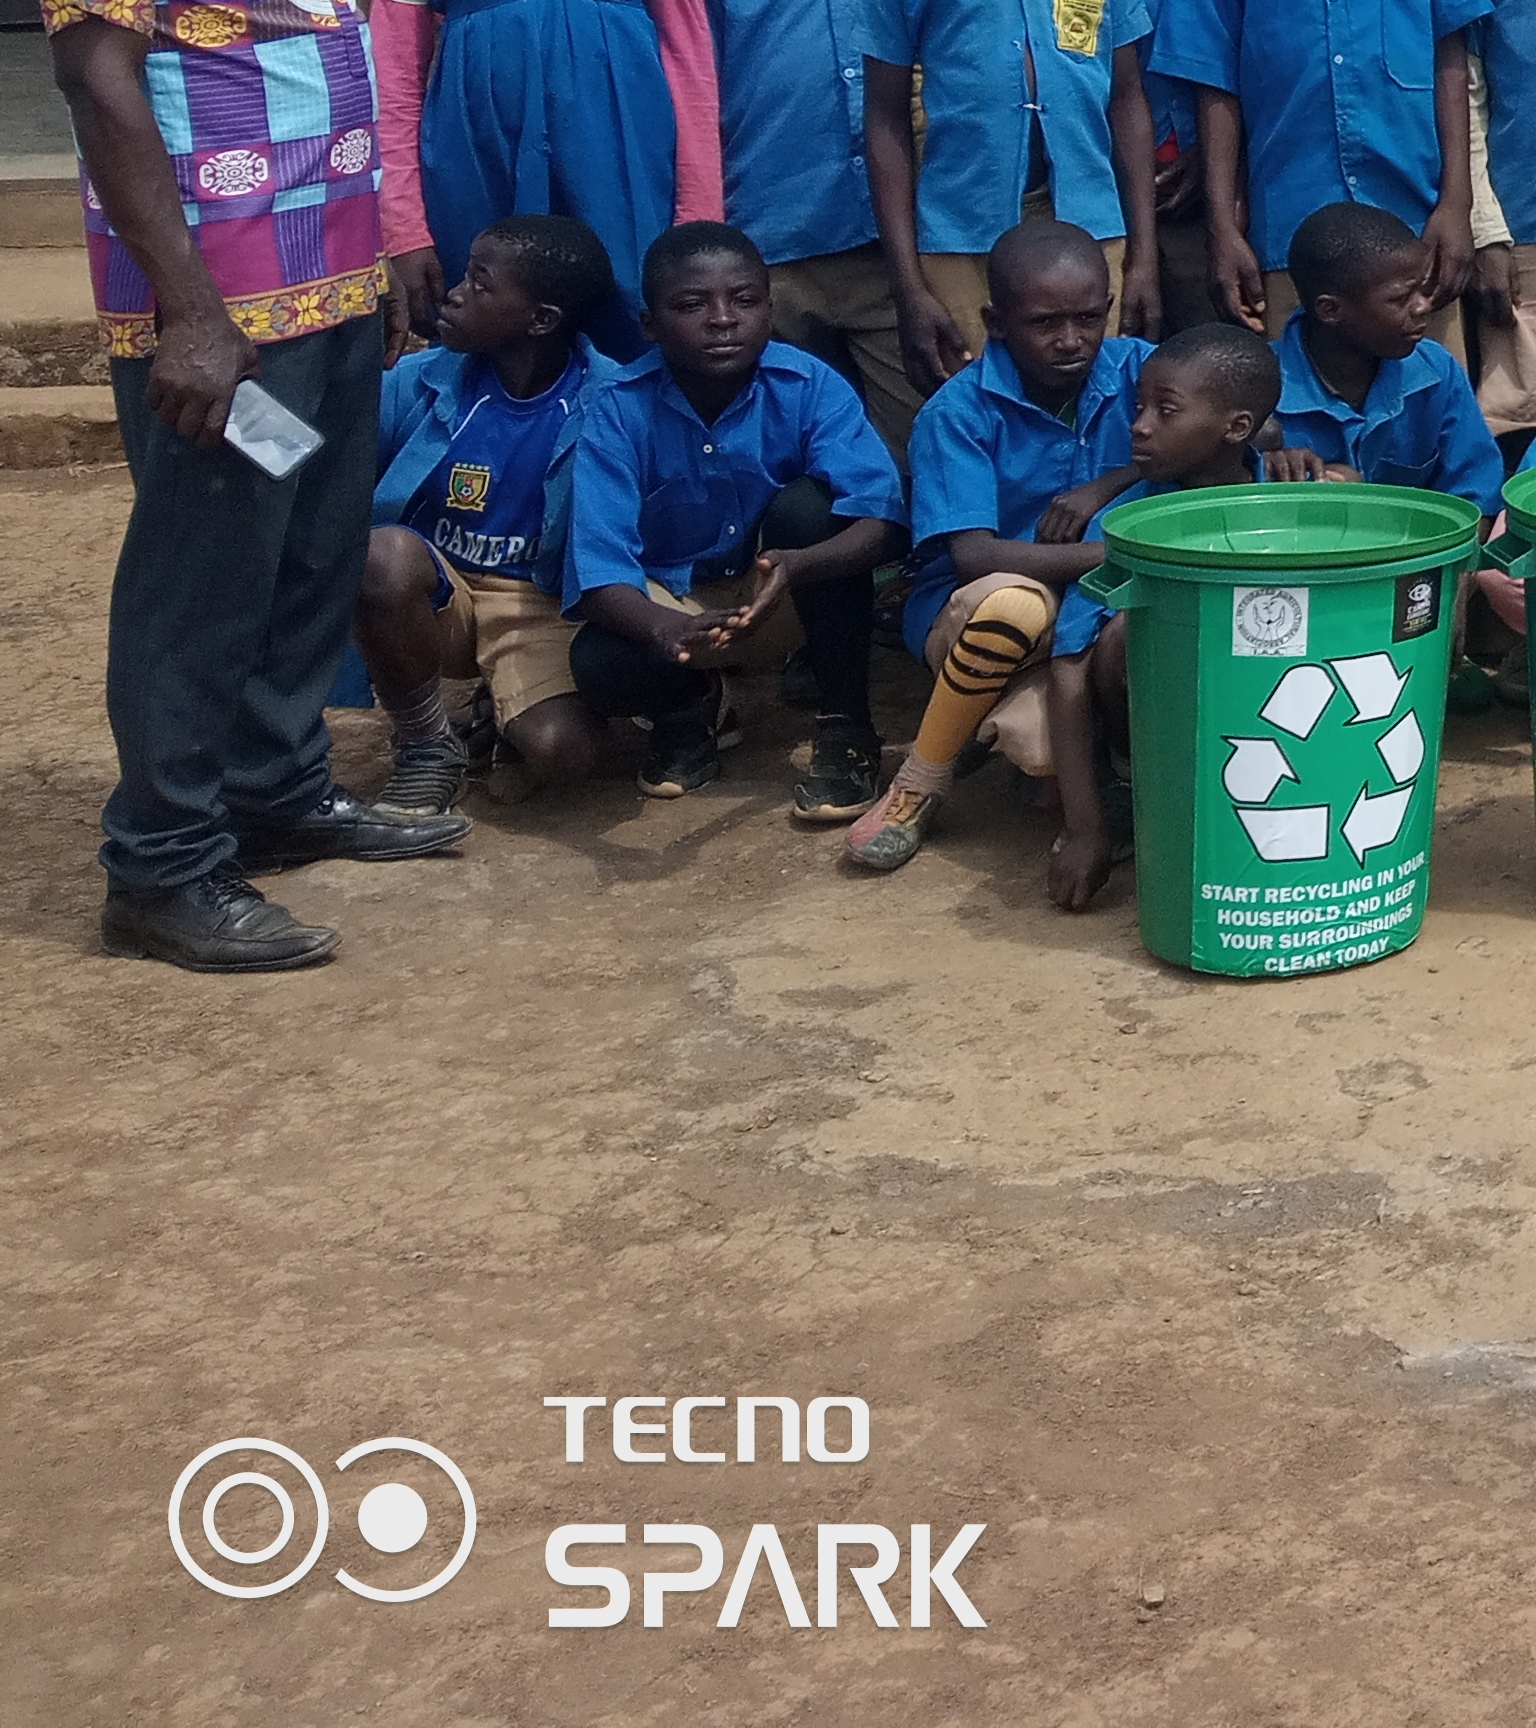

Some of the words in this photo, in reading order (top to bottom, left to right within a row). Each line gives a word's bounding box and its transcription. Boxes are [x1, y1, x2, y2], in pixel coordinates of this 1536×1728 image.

[1201, 883, 1260, 903] START
[1265, 875, 1372, 904] RECYCLING
[1378, 869, 1393, 887] IN
[1398, 851, 1424, 879] YOUR
[1217, 905, 1341, 927] HOUSEHOLD
[1345, 895, 1381, 918] AND
[1385, 879, 1416, 907] KEEP
[1219, 933, 1273, 950] YOUR
[1279, 903, 1412, 949] SURROUNDINGS
[1264, 951, 1331, 972] CLEAN
[1337, 936, 1389, 963] TODAY
